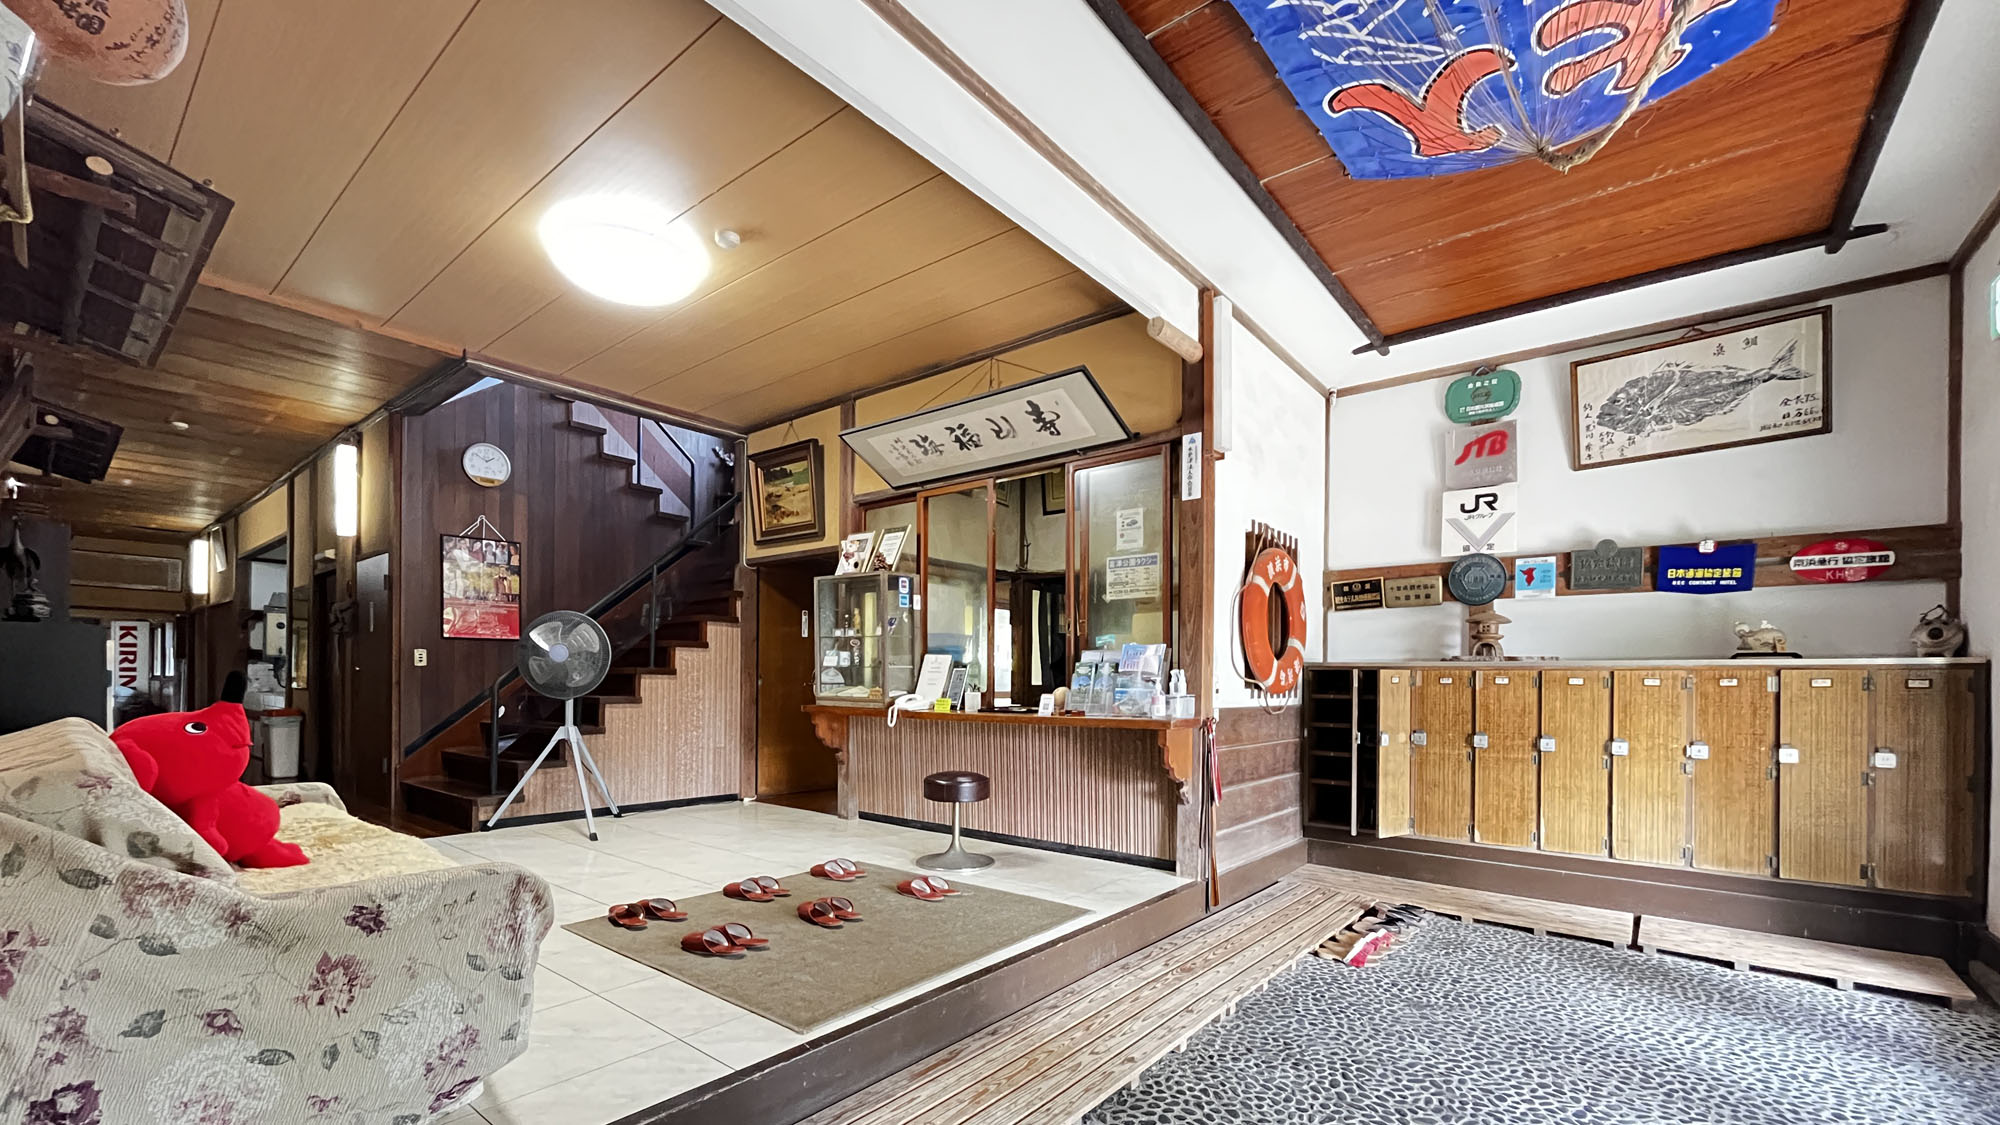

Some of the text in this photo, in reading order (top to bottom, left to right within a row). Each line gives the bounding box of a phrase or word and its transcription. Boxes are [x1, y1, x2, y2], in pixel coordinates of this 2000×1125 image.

[1454, 429, 1509, 465] JTB
[1460, 492, 1498, 513] JR
[119, 625, 137, 691] KIRIN
